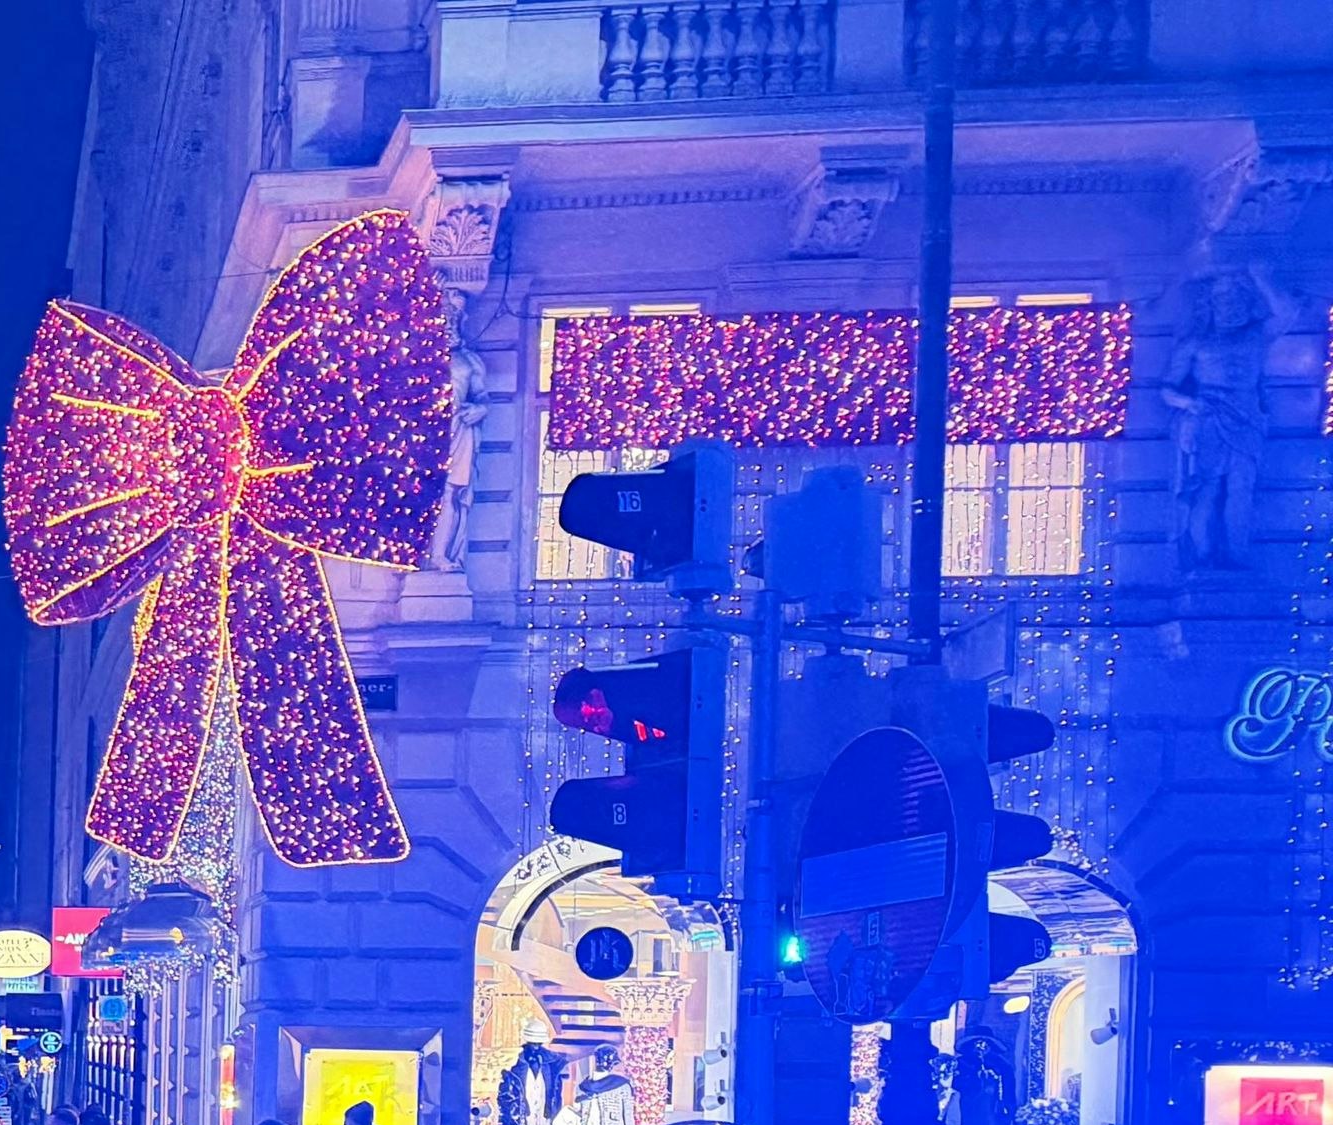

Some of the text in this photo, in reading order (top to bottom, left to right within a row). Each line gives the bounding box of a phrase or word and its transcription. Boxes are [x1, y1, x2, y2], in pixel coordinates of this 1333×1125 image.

[619, 492, 640, 511] 16
[615, 804, 625, 823] 8
[1245, 1092, 1318, 1116] ART
